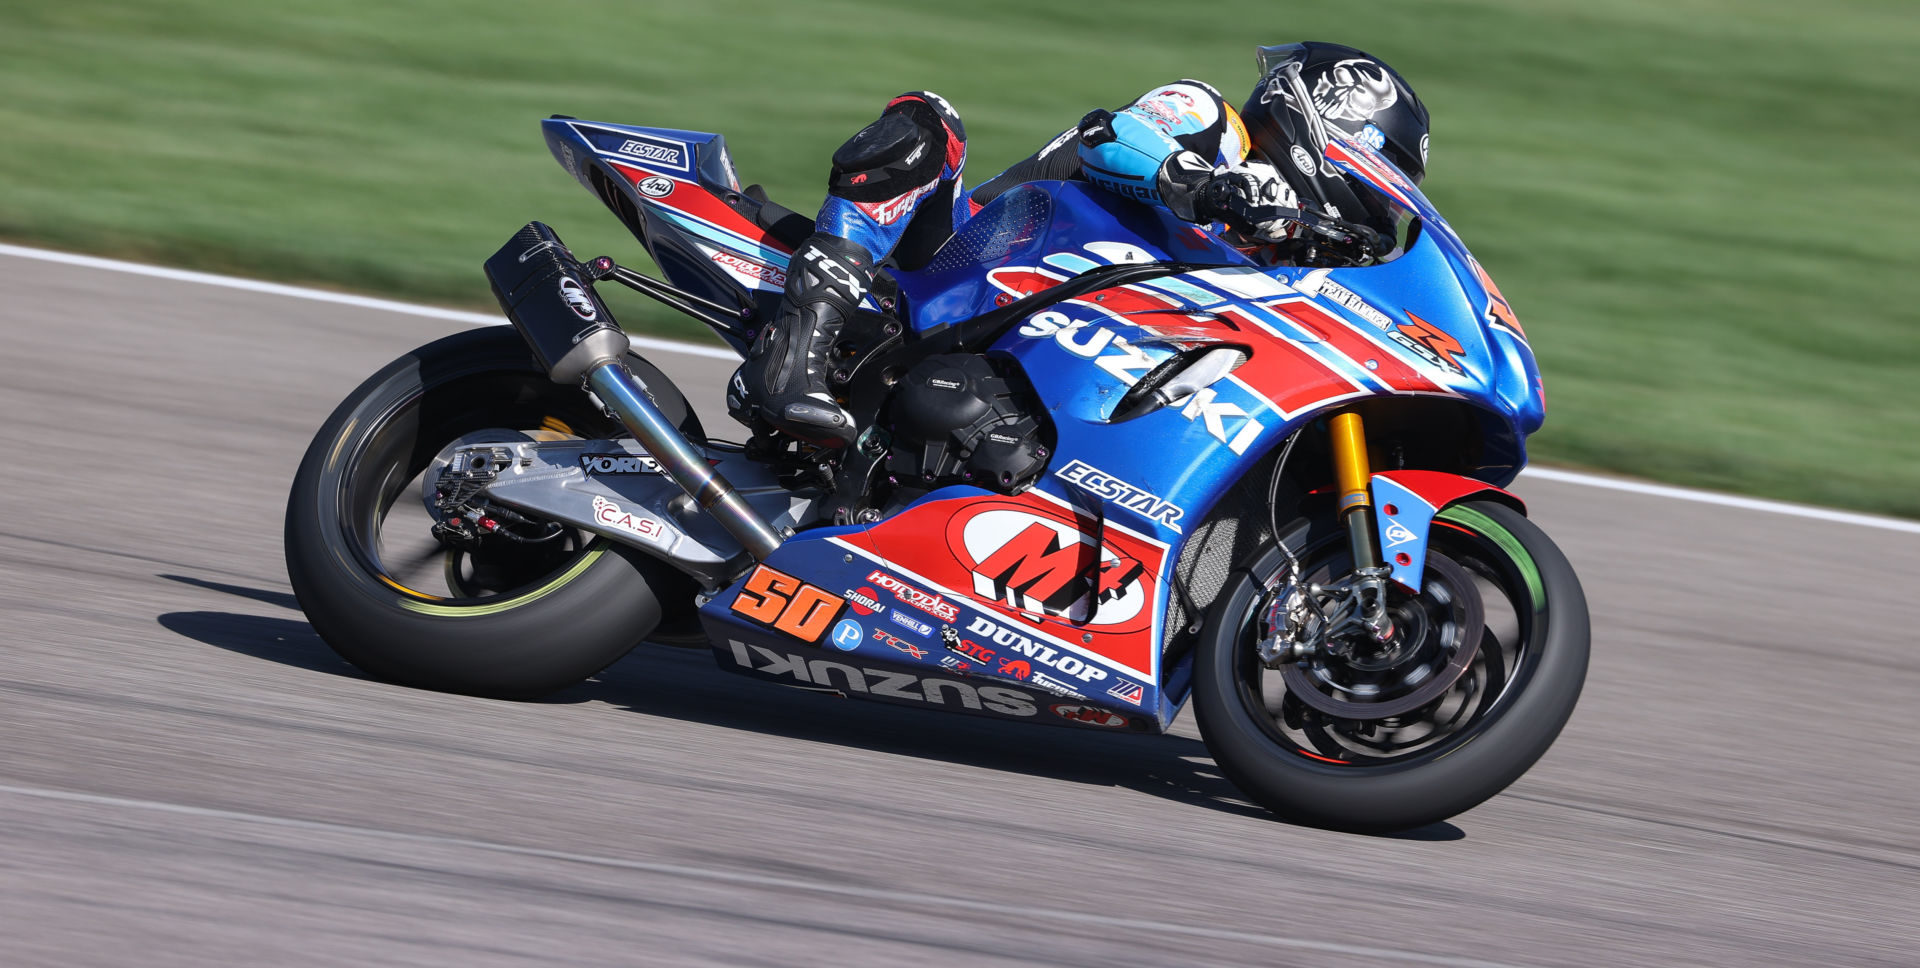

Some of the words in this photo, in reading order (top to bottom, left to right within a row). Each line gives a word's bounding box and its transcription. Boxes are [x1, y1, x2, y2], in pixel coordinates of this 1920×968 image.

[618, 139, 681, 164] ECSTAR
[640, 177, 672, 193] Arai
[712, 252, 787, 284] HOTBODIE
[803, 245, 867, 300] TCX
[1396, 308, 1467, 371] R
[1018, 311, 1265, 457] SUZKI
[1055, 459, 1184, 534] ECSTAR
[971, 521, 1143, 624] M4
[730, 563, 848, 643] 50
[843, 588, 886, 614] SHORAI
[896, 594, 955, 622] RCING.COM
[839, 623, 861, 647] P
[892, 611, 921, 630] VENHILL
[871, 628, 928, 660] TCX
[956, 639, 996, 662] STG
[966, 616, 1108, 682] DUNLOP
[728, 639, 1038, 717] SUZUKI
